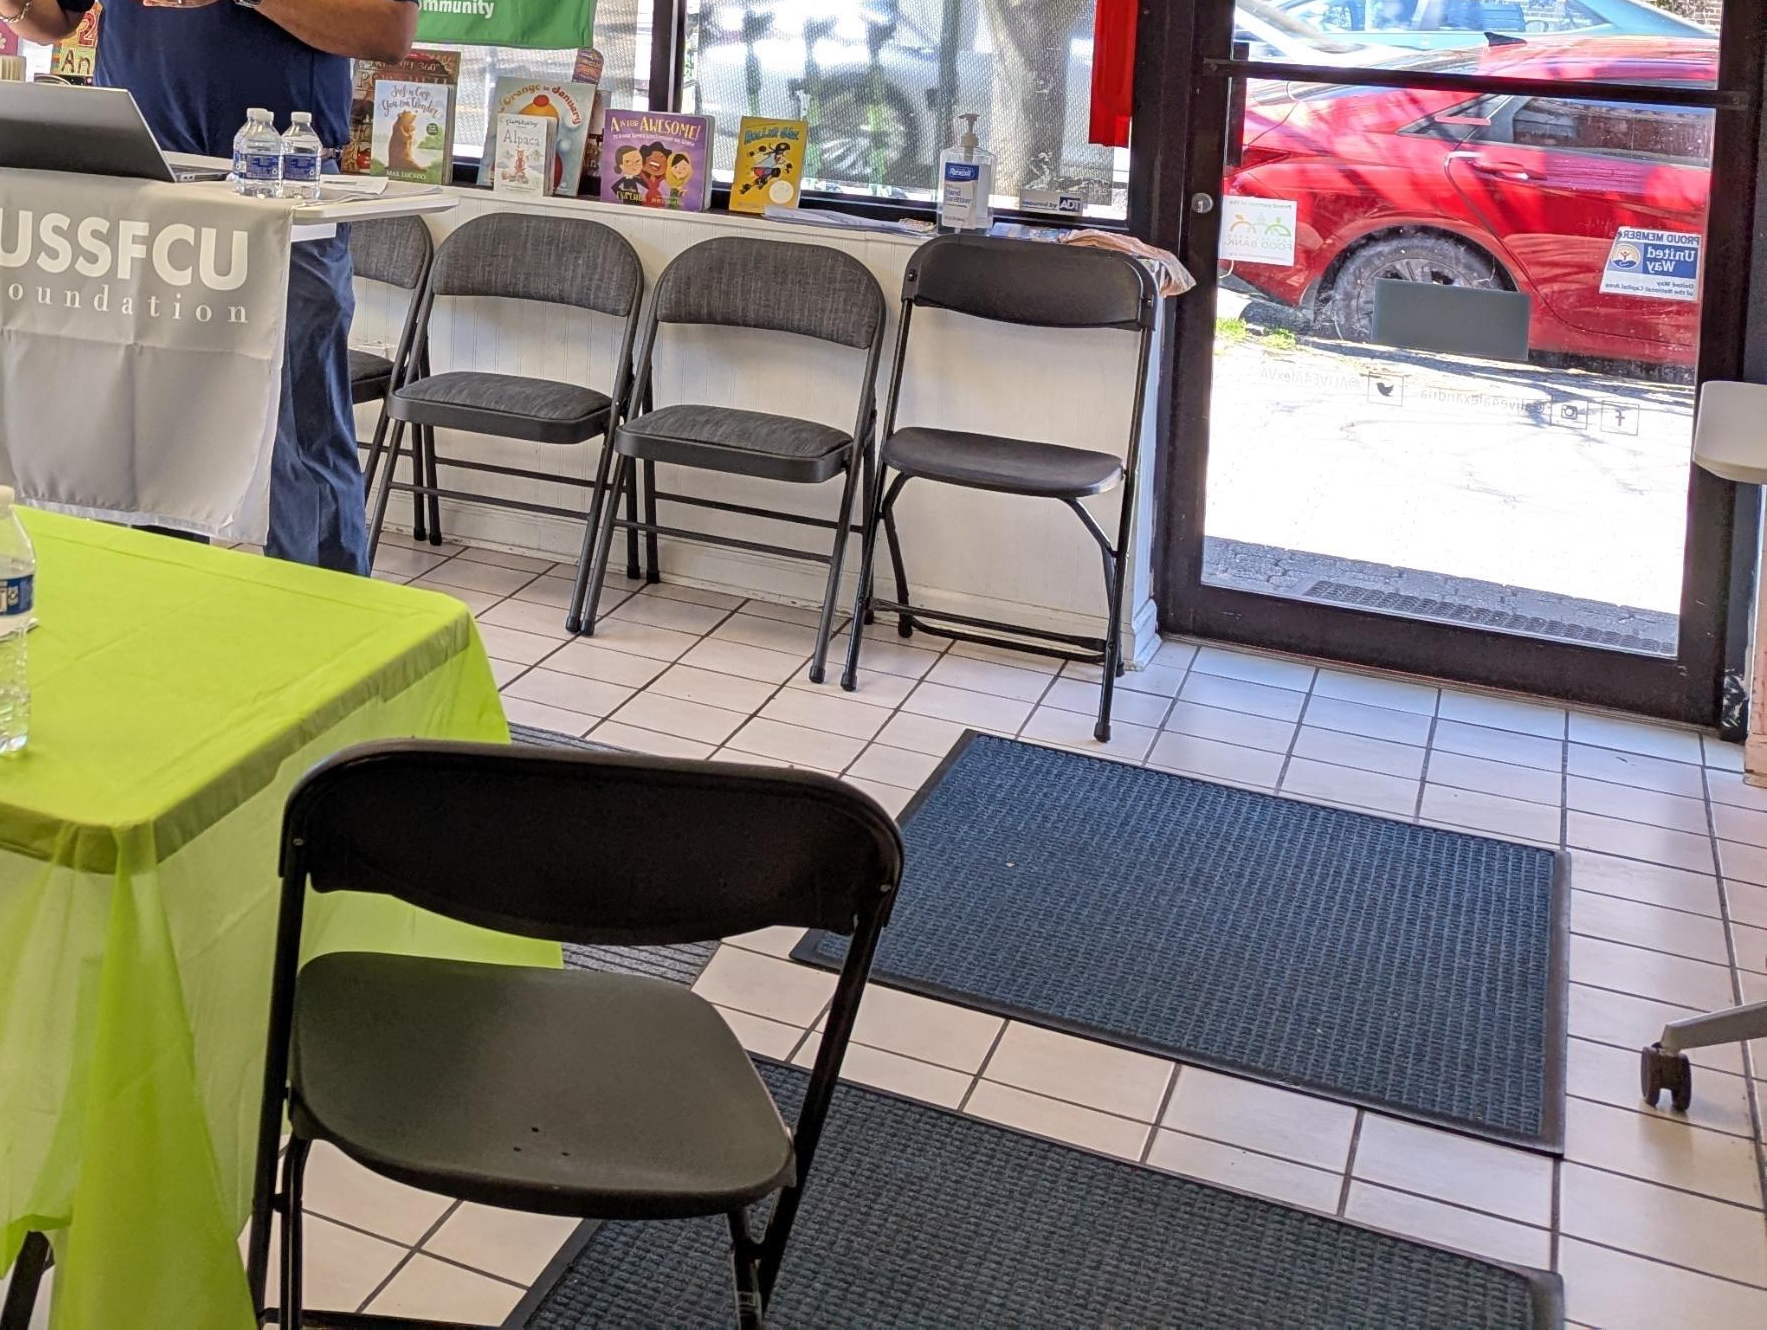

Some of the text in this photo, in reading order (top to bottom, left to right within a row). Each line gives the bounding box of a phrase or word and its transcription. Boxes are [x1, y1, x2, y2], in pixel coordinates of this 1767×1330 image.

[551, 86, 582, 125] January
[503, 129, 540, 148] Alpaca
[611, 116, 620, 132] A
[639, 116, 702, 141] AWESOME!
